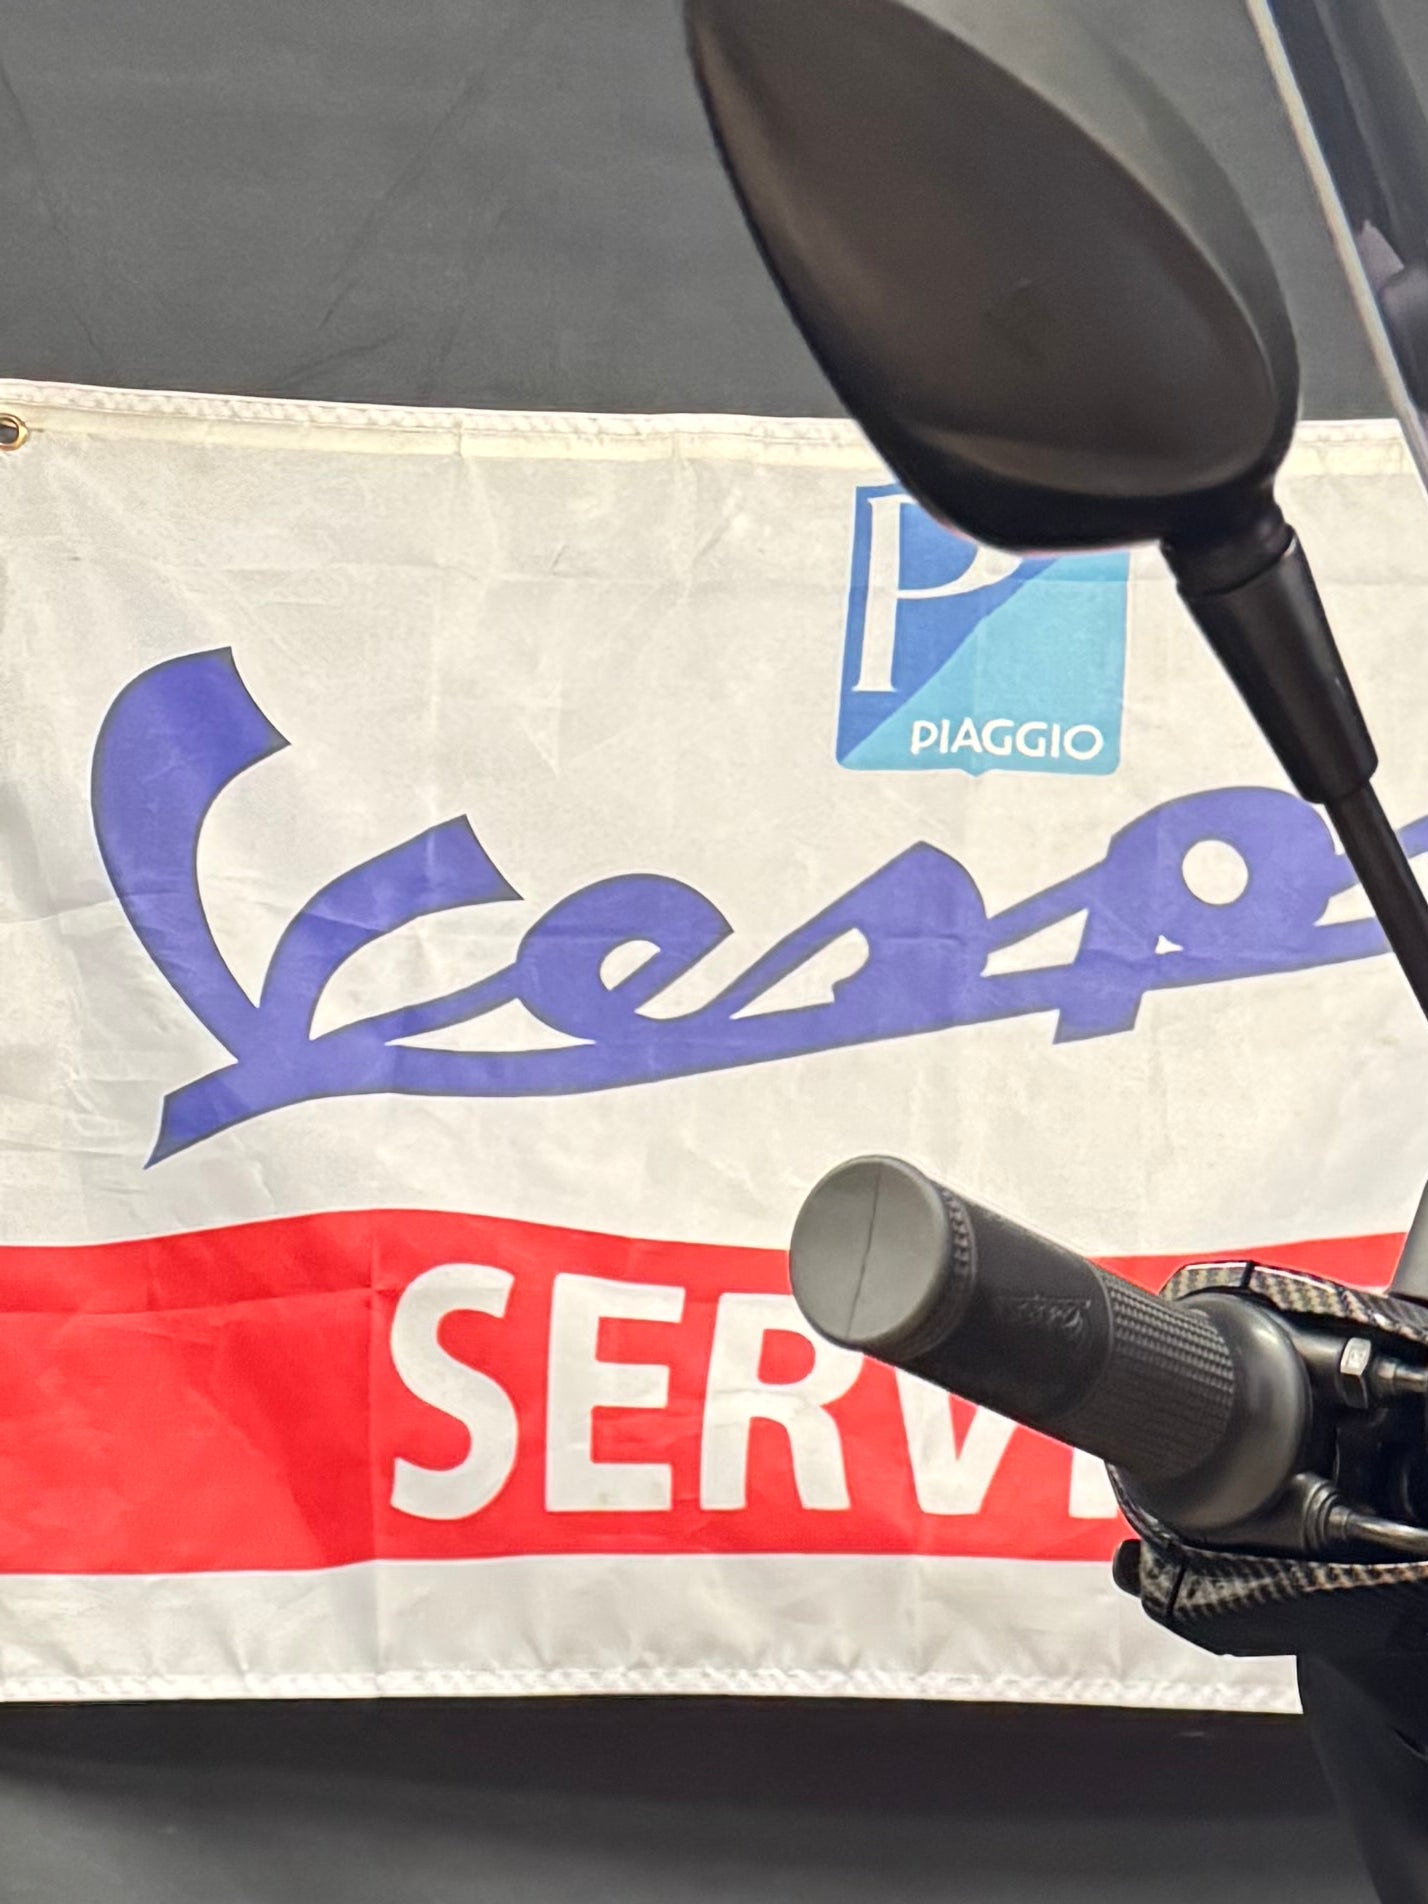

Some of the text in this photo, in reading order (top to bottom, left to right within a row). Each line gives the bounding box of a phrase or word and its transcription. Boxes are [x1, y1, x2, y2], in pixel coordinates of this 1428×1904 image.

[851, 493, 1024, 692] P
[910, 717, 1105, 761] PIAGGIO
[390, 1262, 1118, 1521] SERV
